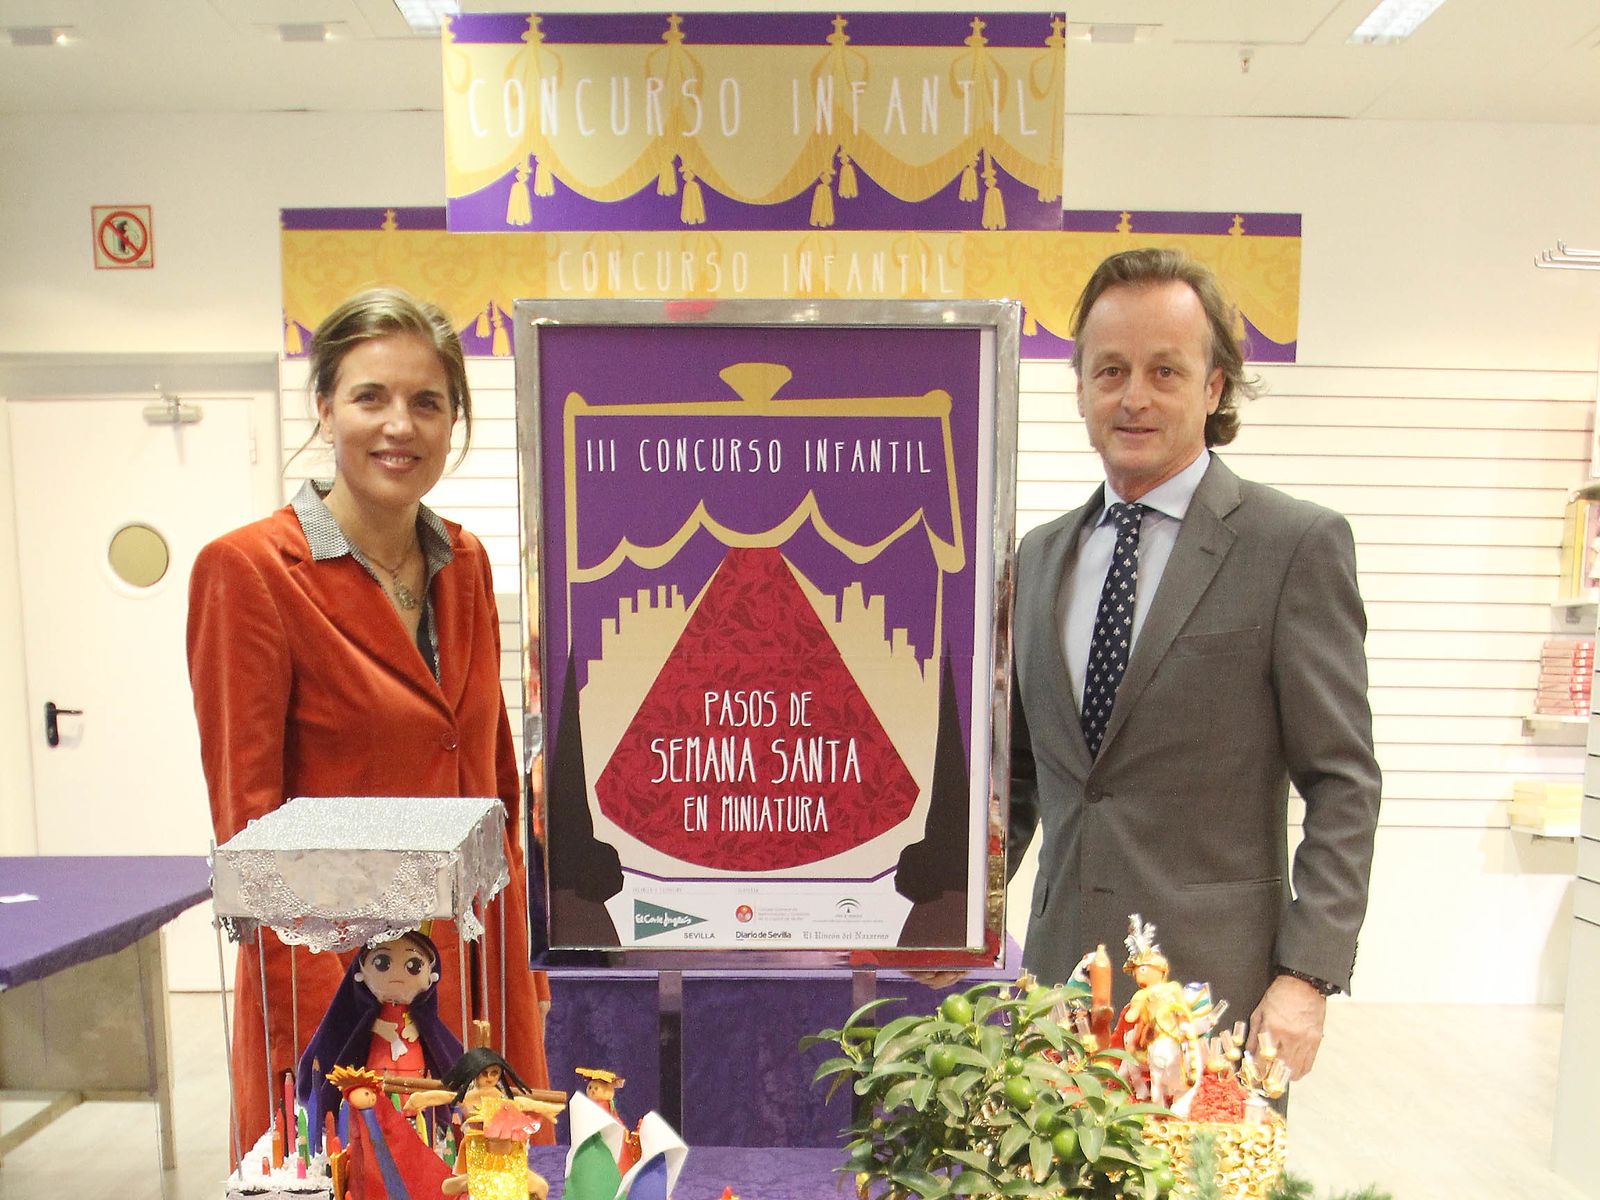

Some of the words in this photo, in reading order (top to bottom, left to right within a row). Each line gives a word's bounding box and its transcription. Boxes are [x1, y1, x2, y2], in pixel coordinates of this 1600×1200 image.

[468, 75, 741, 138] CONCURSO
[792, 75, 1039, 136] INFANTIL
[557, 250, 749, 294] CONCURSO
[782, 250, 954, 294] INFANTIL
[586, 438, 617, 473] III
[638, 437, 782, 473] CONCURSO
[804, 438, 931, 473] INFANTIL
[704, 690, 778, 727] PASOS
[789, 691, 813, 727] DE
[650, 735, 757, 784] SEMANA
[771, 736, 862, 784] SANTA
[683, 794, 708, 832] EN
[720, 794, 829, 833] MINIATURA
[683, 932, 716, 940] SEVILLA
[735, 931, 758, 940] Diario
[758, 931, 767, 940] de
[767, 931, 792, 940] Sevilla
